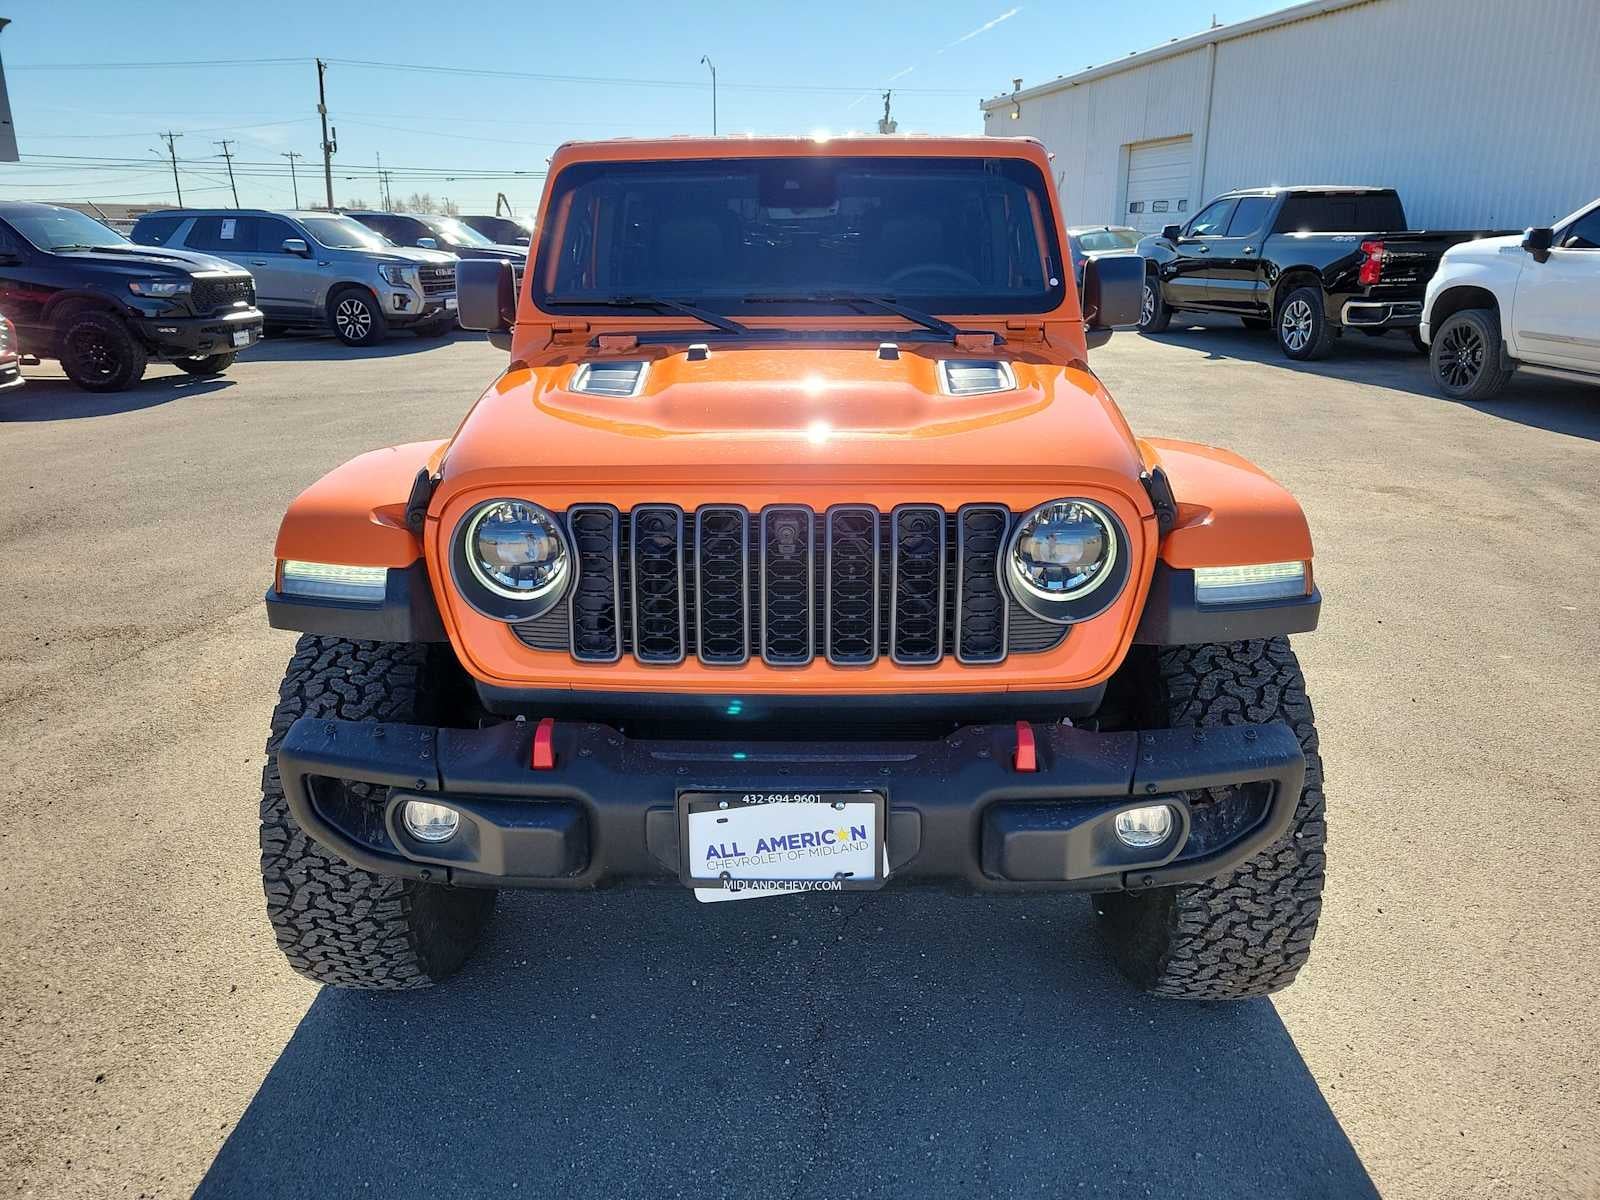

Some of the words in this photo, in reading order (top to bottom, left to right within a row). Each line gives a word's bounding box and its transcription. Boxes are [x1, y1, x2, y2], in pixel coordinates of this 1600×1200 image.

[742, 794, 821, 804] 432-694-9601
[706, 842, 746, 861] ALL
[706, 852, 783, 871] CHEVROLET
[787, 849, 805, 861] OF
[808, 841, 869, 857] MIDLAND
[723, 879, 842, 891] MIDLANDCHEVY.COM
